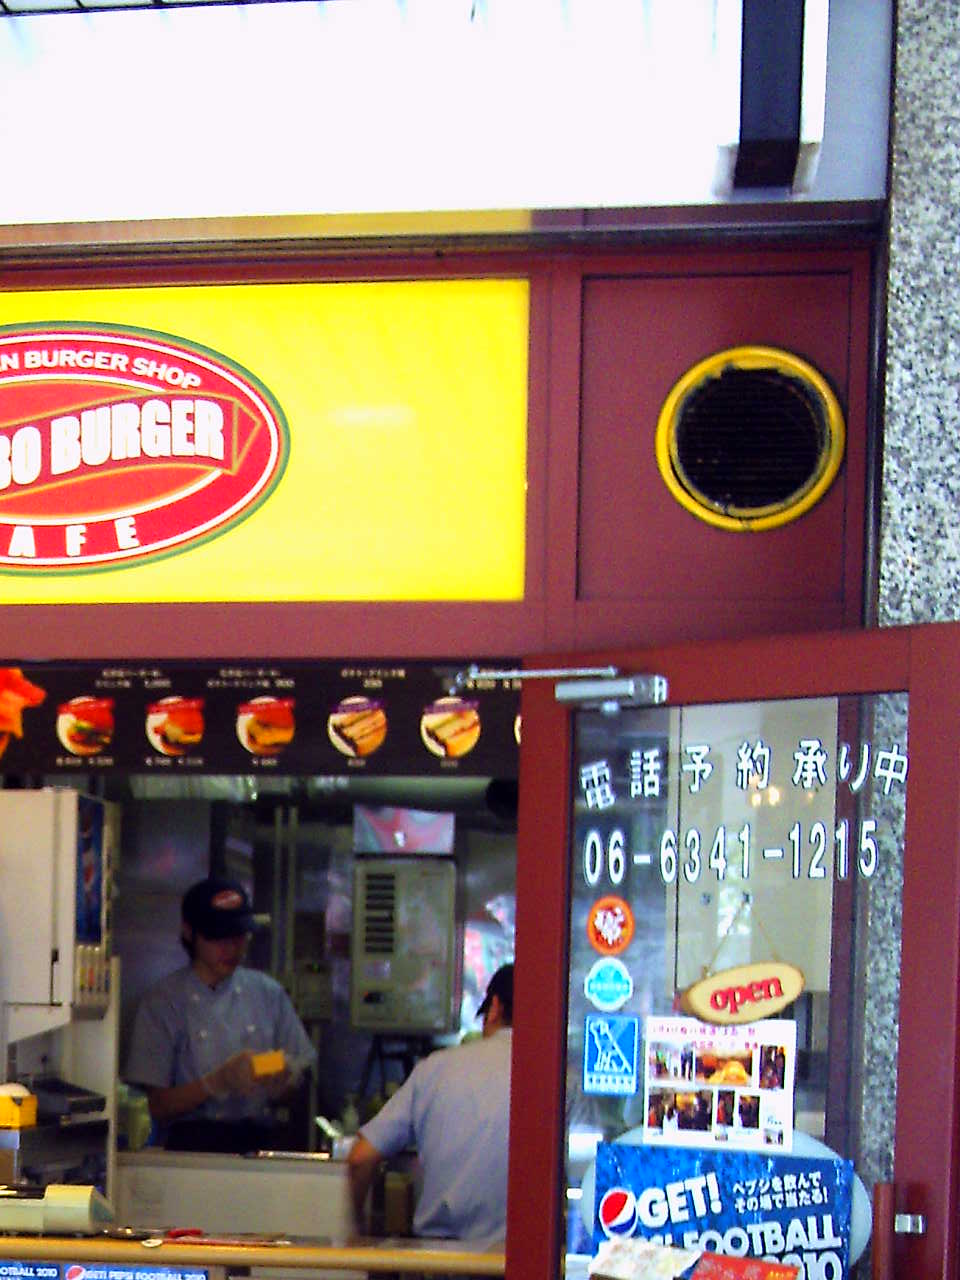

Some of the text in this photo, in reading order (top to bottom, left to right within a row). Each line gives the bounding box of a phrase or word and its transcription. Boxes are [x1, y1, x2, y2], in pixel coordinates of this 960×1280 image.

[24, 349, 127, 372] BURGER
[131, 357, 202, 391] SHOP
[50, 399, 224, 476] BURGER
[581, 739, 909, 810] 電話予約承り中
[584, 820, 880, 885] 06-6341-1215
[709, 976, 784, 1014] open
[638, 1171, 723, 1229] GET!
